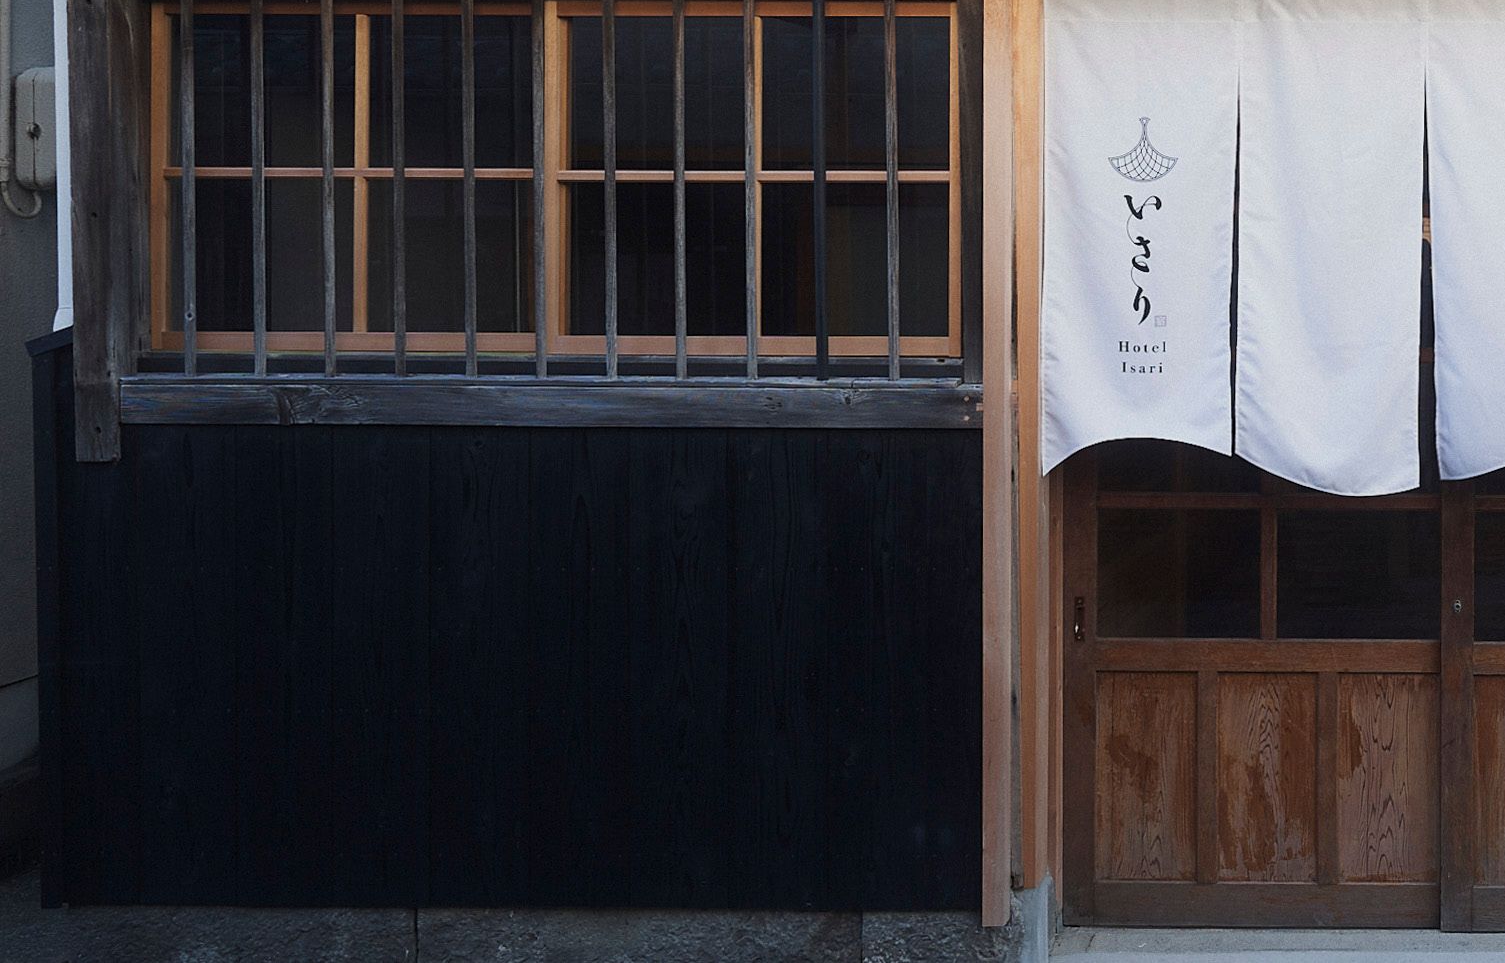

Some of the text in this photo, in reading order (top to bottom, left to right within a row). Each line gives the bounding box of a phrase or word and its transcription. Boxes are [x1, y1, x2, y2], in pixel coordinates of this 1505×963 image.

[1123, 194, 1162, 325] いさり
[1118, 340, 1167, 354] Hotel
[1122, 361, 1164, 374] Isari
